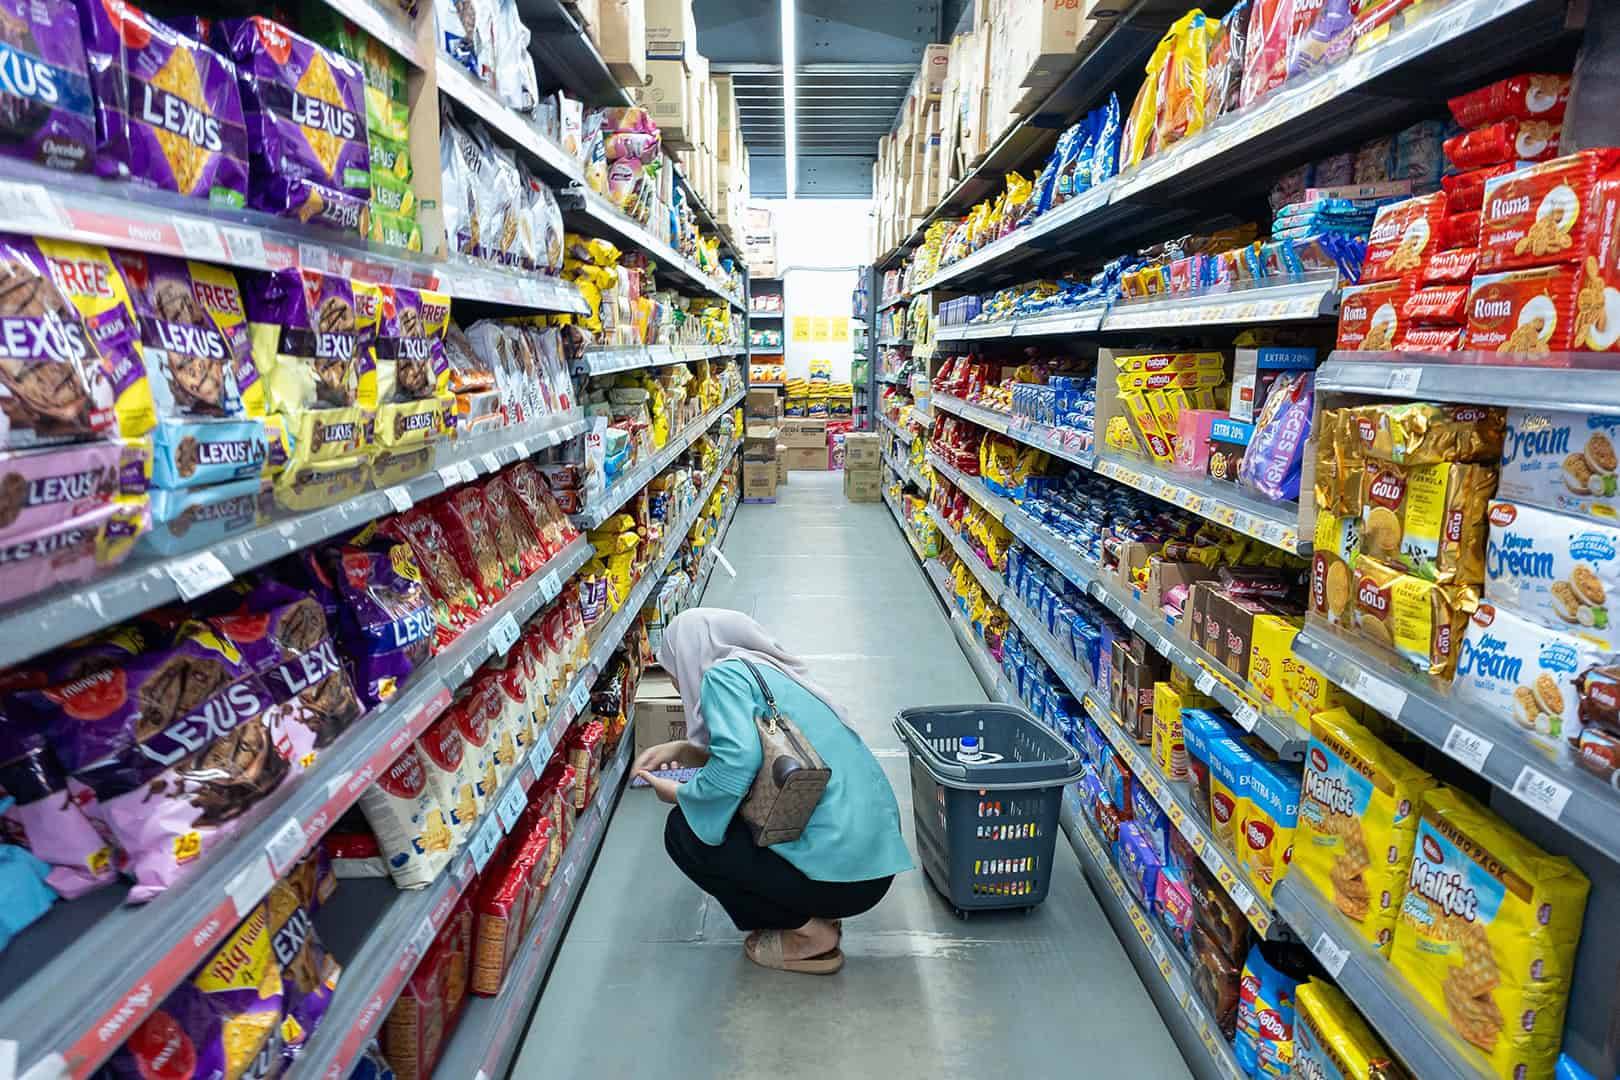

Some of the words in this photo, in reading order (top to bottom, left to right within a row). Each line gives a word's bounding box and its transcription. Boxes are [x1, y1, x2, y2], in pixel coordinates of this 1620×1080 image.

[143, 85, 222, 151] LEXUS
[292, 91, 355, 138] LEXUS
[378, 187, 401, 209] LEXUS
[1491, 196, 1530, 219] Roma
[194, 281, 240, 313] FREE
[421, 304, 447, 322] FREE
[1343, 306, 1367, 320] Roma
[1475, 299, 1511, 318] Roma
[0, 319, 86, 361] EXUS
[156, 319, 224, 359] LEXUS
[317, 333, 353, 360] LEXU
[405, 413, 432, 430] LEXUS
[1456, 406, 1487, 421] GOLD
[200, 441, 247, 463] LEXUS
[1500, 425, 1571, 466] Cream
[29, 474, 96, 505] LEXUS
[1372, 482, 1400, 499] GOLD
[1452, 513, 1462, 540] GOLD
[1487, 540, 1554, 580] Cream
[1360, 589, 1385, 610] GOLD
[393, 607, 436, 647] LEXUS
[1457, 637, 1522, 684] Cream
[139, 683, 261, 767] LEXUS
[1322, 735, 1350, 760] JUMBO
[1350, 756, 1376, 780] PACK
[1304, 768, 1353, 817] Malkist
[1436, 819, 1473, 852] JUMBO
[1474, 847, 1506, 880] PACK
[1410, 856, 1477, 922] Malkist
[212, 943, 253, 985] Big
